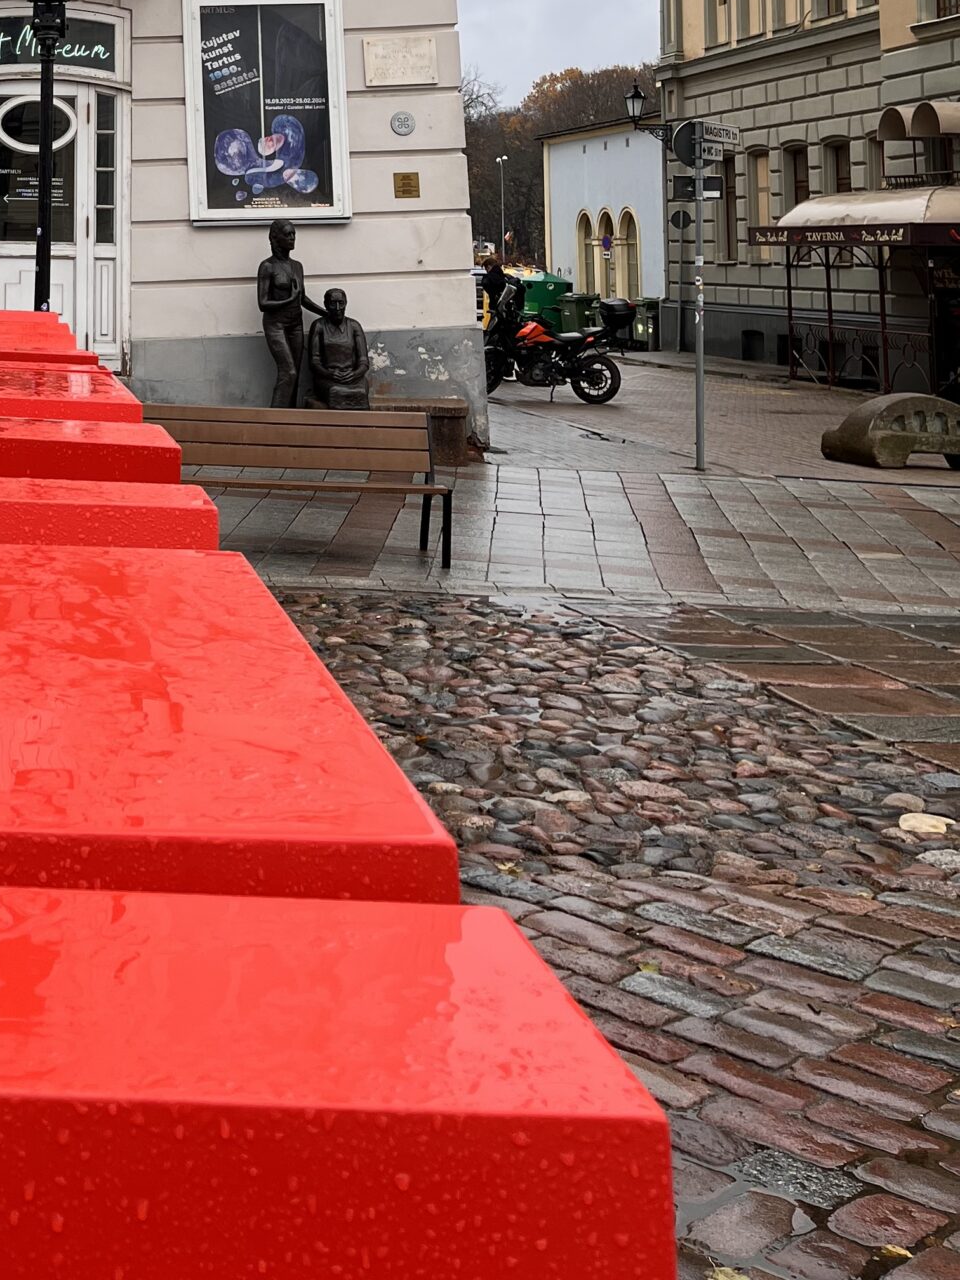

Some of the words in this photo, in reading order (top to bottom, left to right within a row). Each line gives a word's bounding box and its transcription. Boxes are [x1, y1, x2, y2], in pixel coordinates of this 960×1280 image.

[200, 29, 241, 49] Kujutav
[201, 43, 234, 61] kunst
[204, 53, 242, 71] Tartus
[213, 68, 259, 92] aastatel
[704, 125, 731, 139] MAGISTRI
[805, 231, 845, 242] TAVERNA
